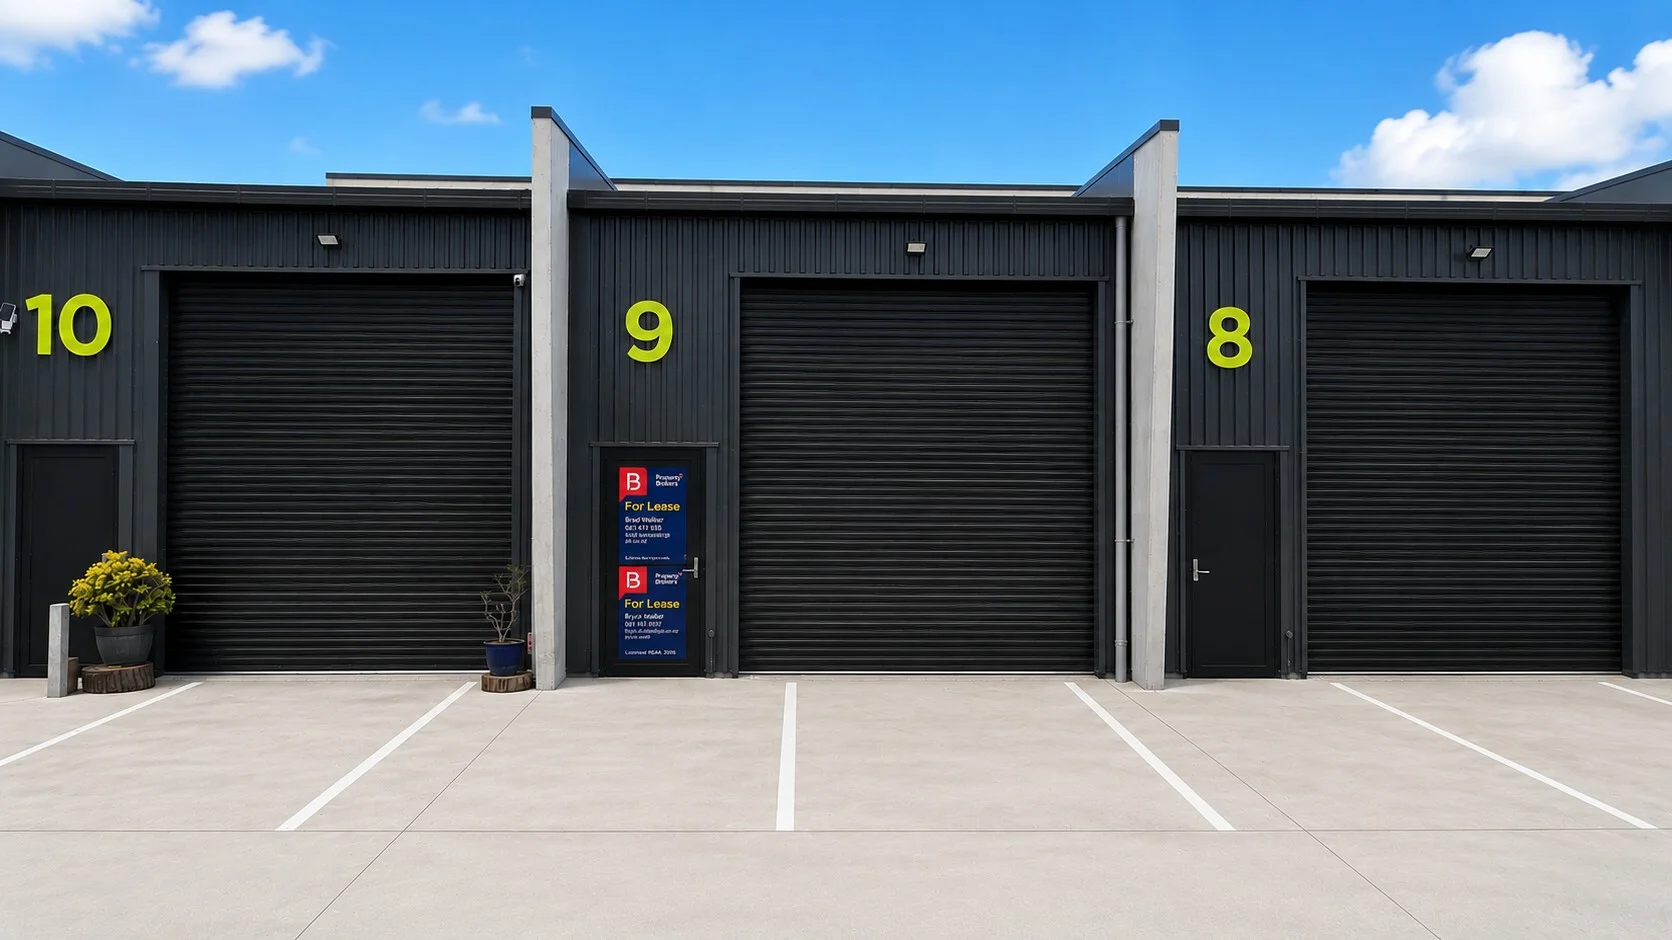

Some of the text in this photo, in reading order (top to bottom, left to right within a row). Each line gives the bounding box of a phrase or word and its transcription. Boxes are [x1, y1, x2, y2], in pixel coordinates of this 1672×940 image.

[24, 293, 112, 357] 10
[625, 299, 674, 363] 9
[1206, 306, 1253, 369] 8
[626, 472, 641, 491] B
[625, 501, 681, 512] For Lease
[626, 571, 641, 589] B
[624, 599, 680, 609] For Lease
